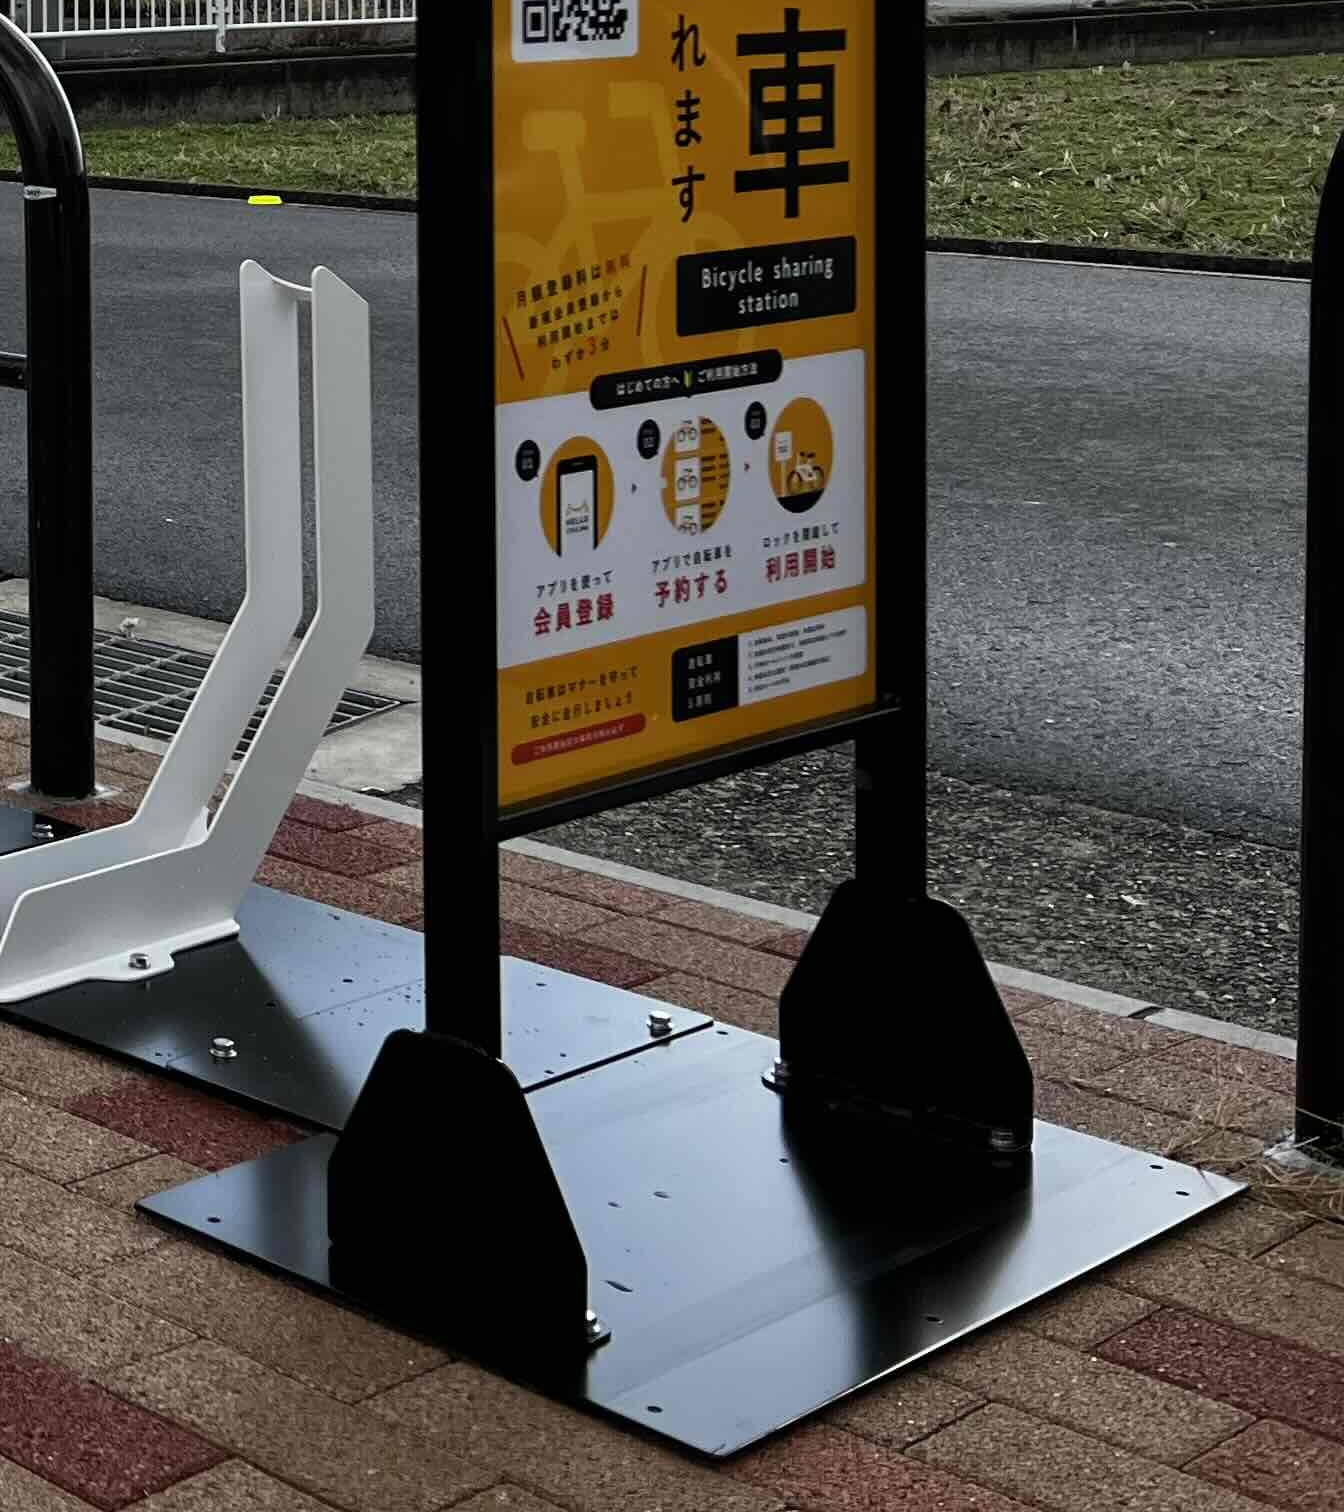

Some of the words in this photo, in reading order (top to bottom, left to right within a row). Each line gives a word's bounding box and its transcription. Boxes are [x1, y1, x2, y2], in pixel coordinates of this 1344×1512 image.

[701, 259, 764, 292] Bicycle
[773, 255, 834, 280] sharing
[738, 289, 799, 314] station
[653, 568, 729, 609] 予約する
[533, 592, 614, 636] 会員登録
